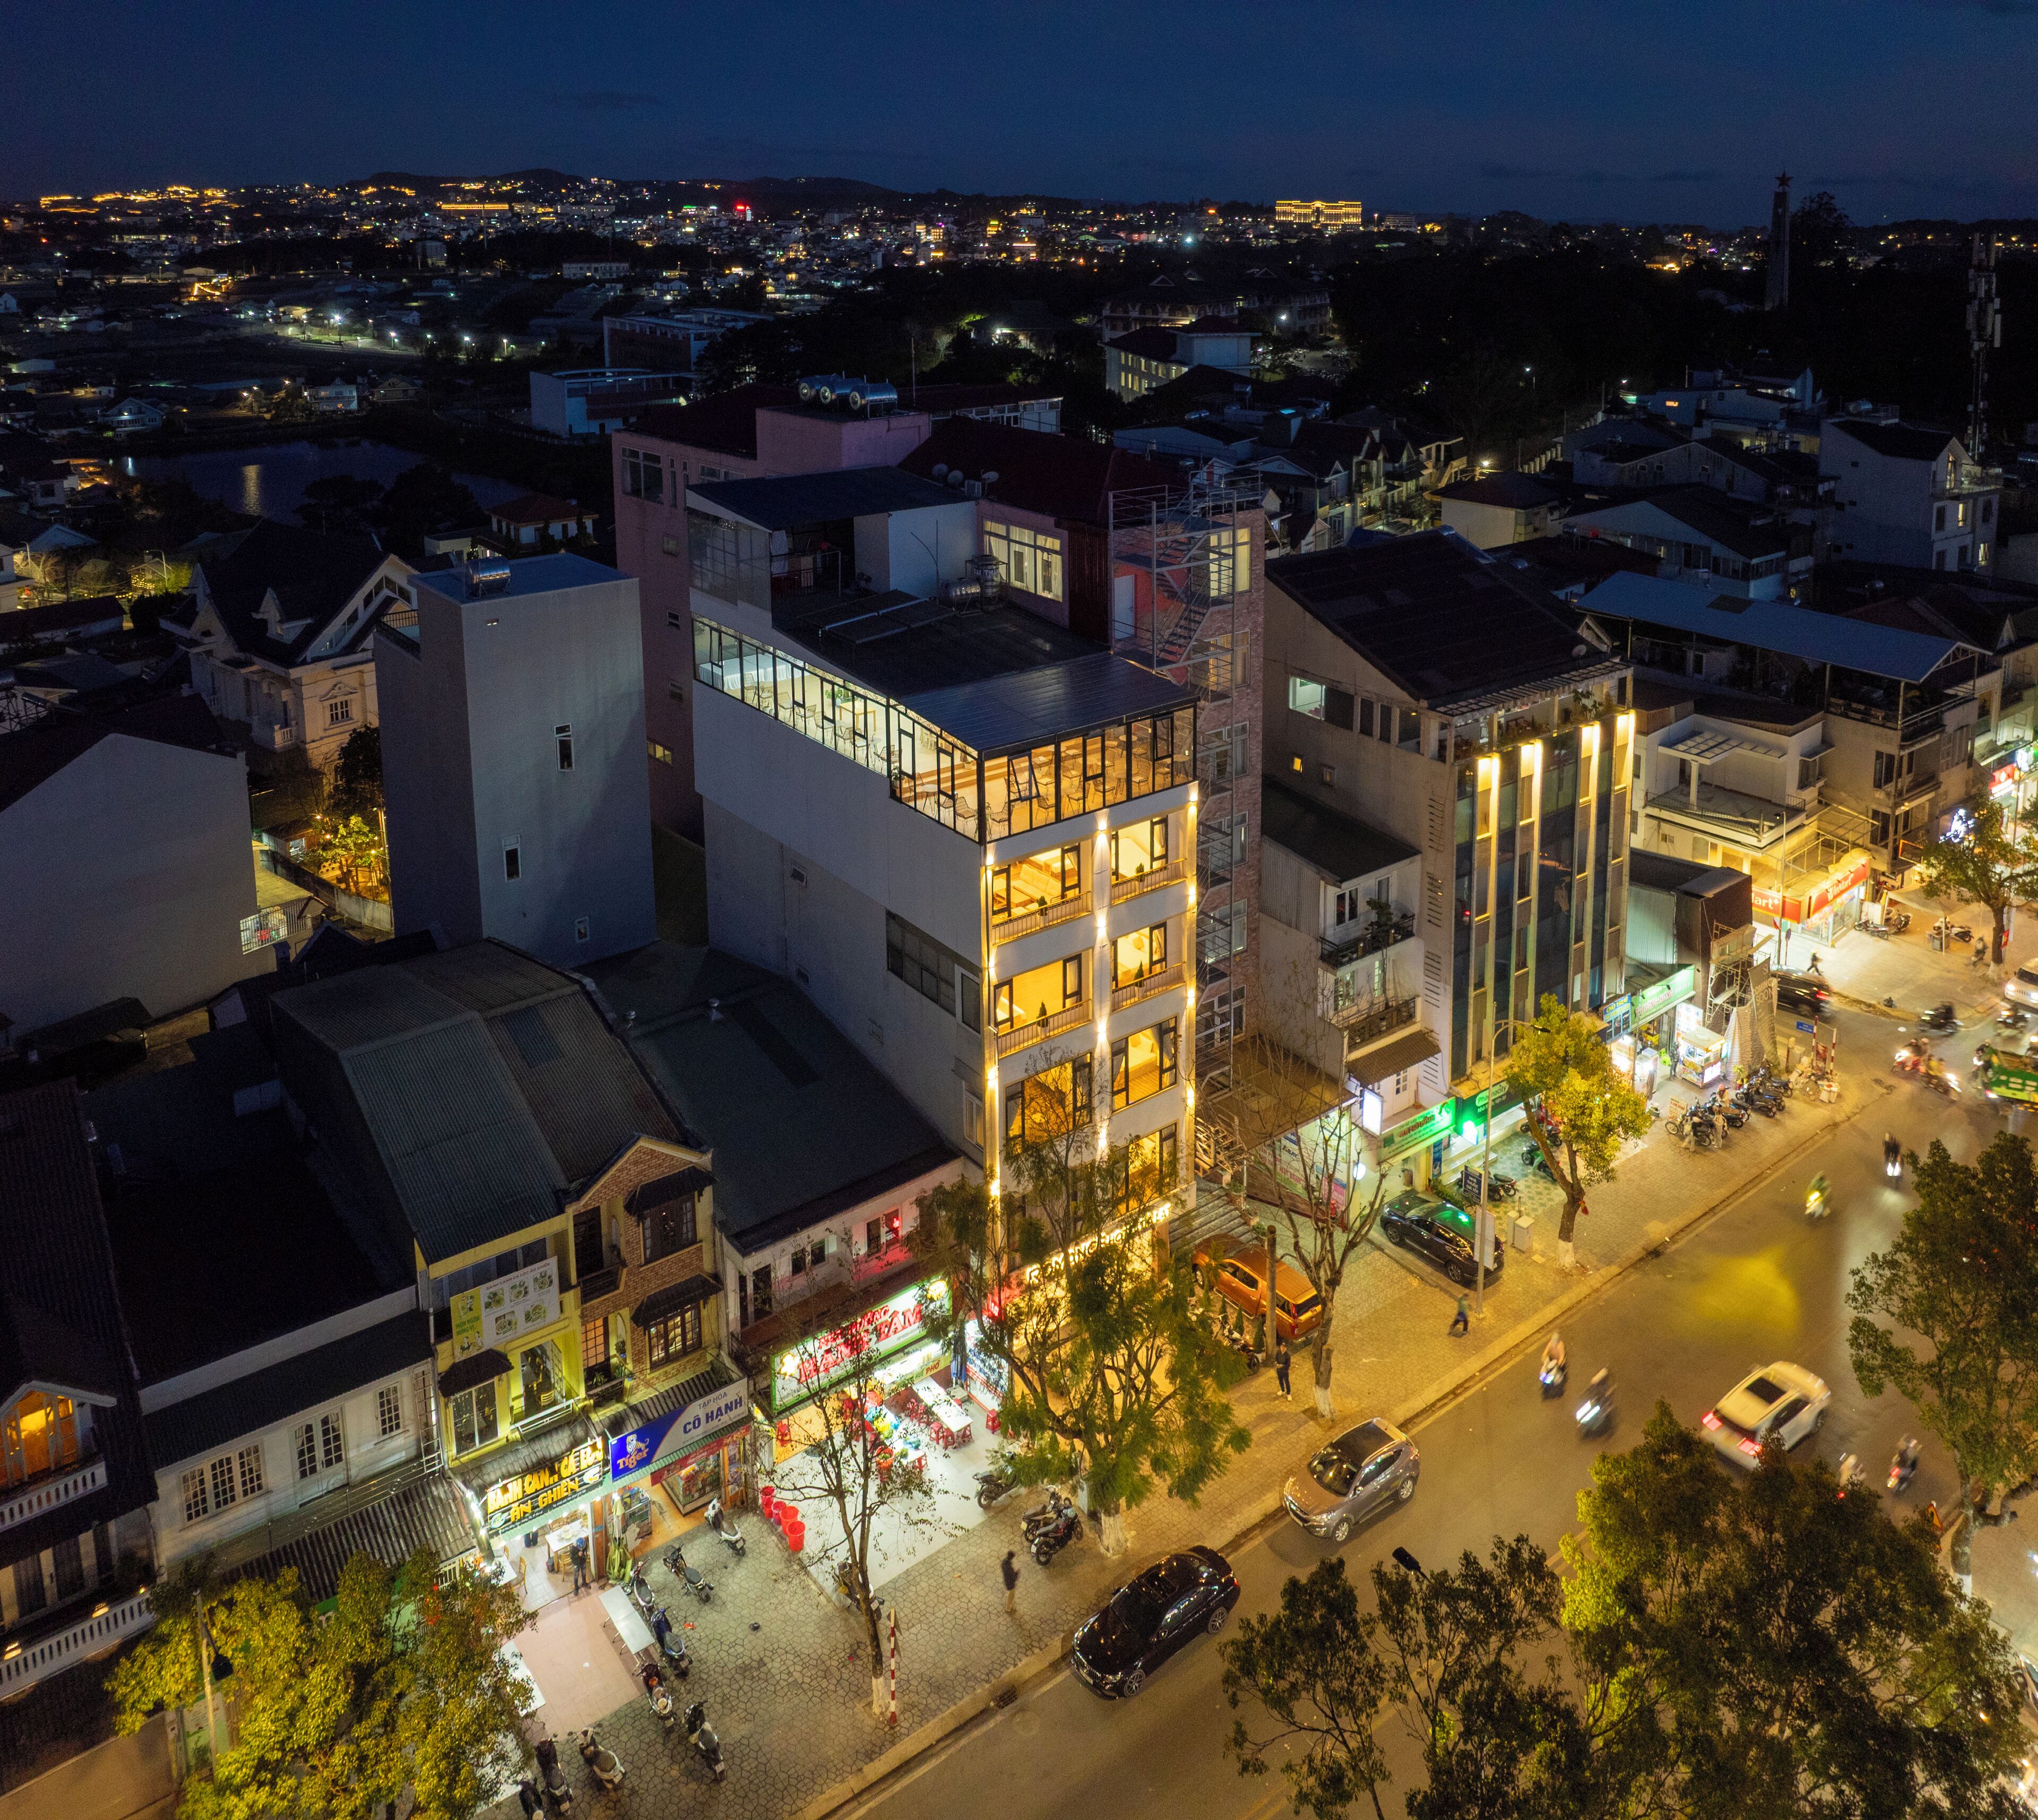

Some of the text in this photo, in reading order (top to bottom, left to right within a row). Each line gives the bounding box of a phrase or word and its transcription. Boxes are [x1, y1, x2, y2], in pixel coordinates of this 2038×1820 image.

[877, 1304, 922, 1342] TÂM
[683, 1415, 701, 1434] CÔ
[705, 1396, 742, 1422] HẠNH
[617, 1447, 649, 1470] Tiger
